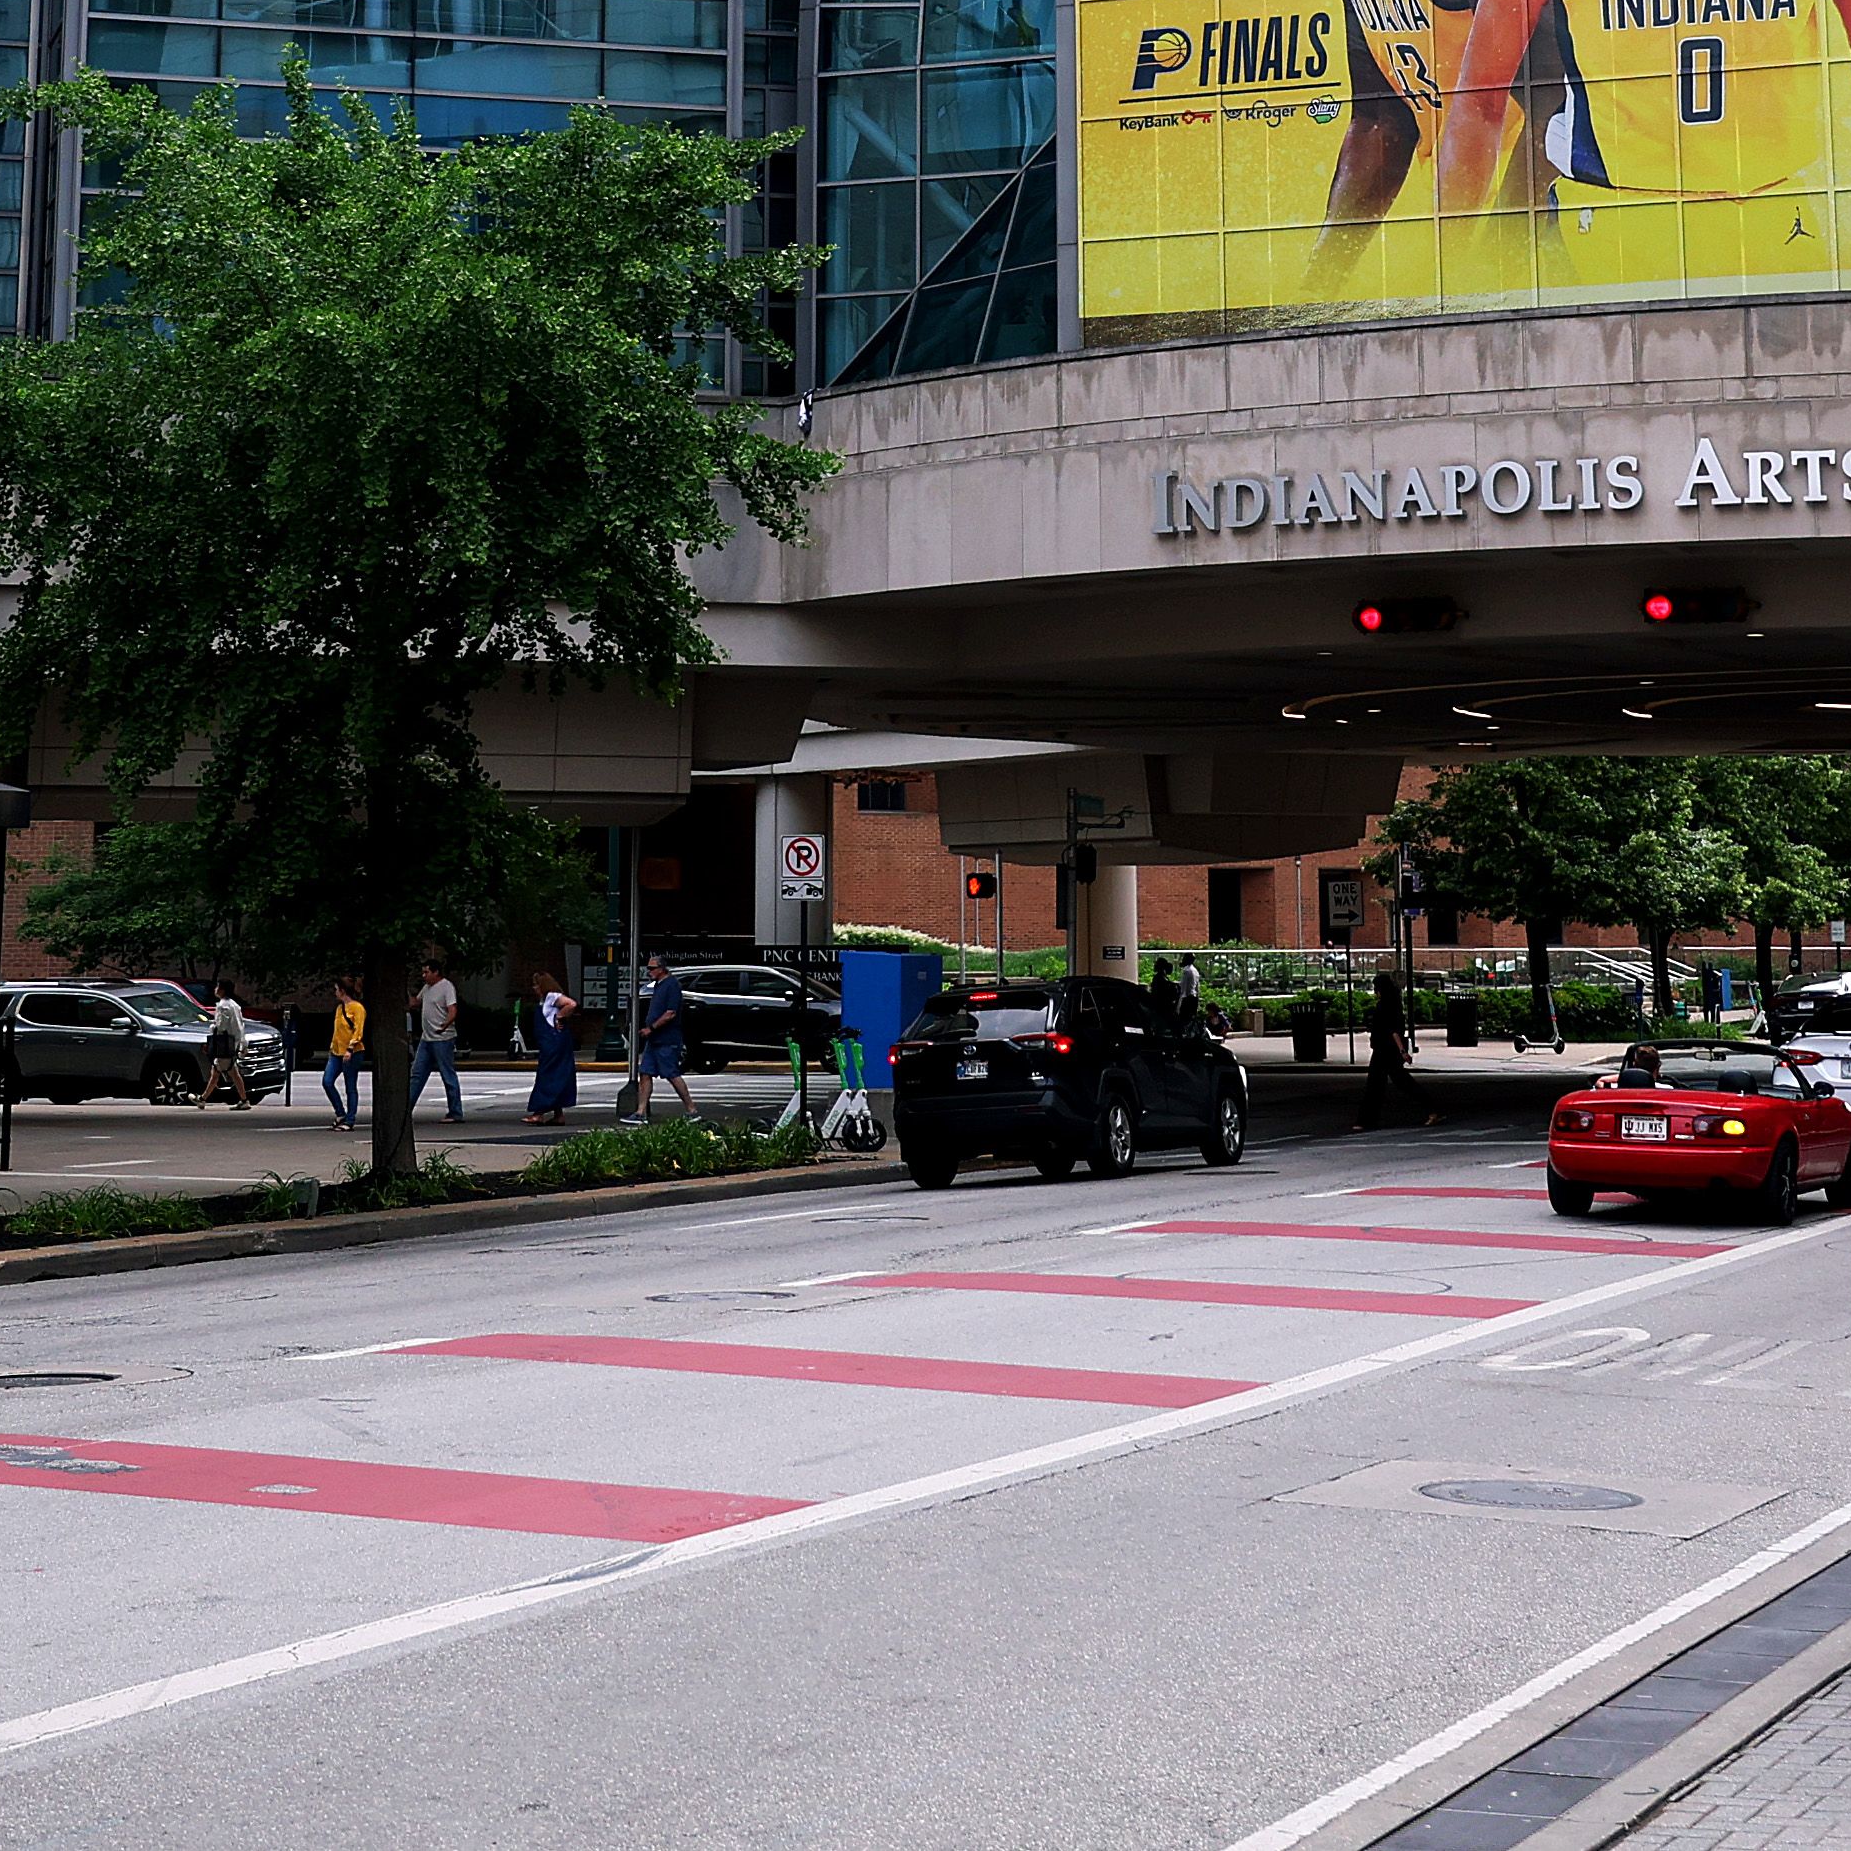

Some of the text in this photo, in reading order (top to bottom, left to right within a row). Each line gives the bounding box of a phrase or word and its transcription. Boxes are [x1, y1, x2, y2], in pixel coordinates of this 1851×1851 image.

[1199, 11, 1331, 87] FINALS
[1678, 36, 1726, 126] 0
[1246, 100, 1296, 128] Kroger
[1306, 99, 1341, 116] Starry
[1119, 115, 1179, 132] KeyBank
[1332, 882, 1357, 894] ONE
[1334, 895, 1358, 907] WAY
[700, 951, 723, 960] Street
[763, 949, 794, 963] PNC
[814, 972, 842, 982] BANK
